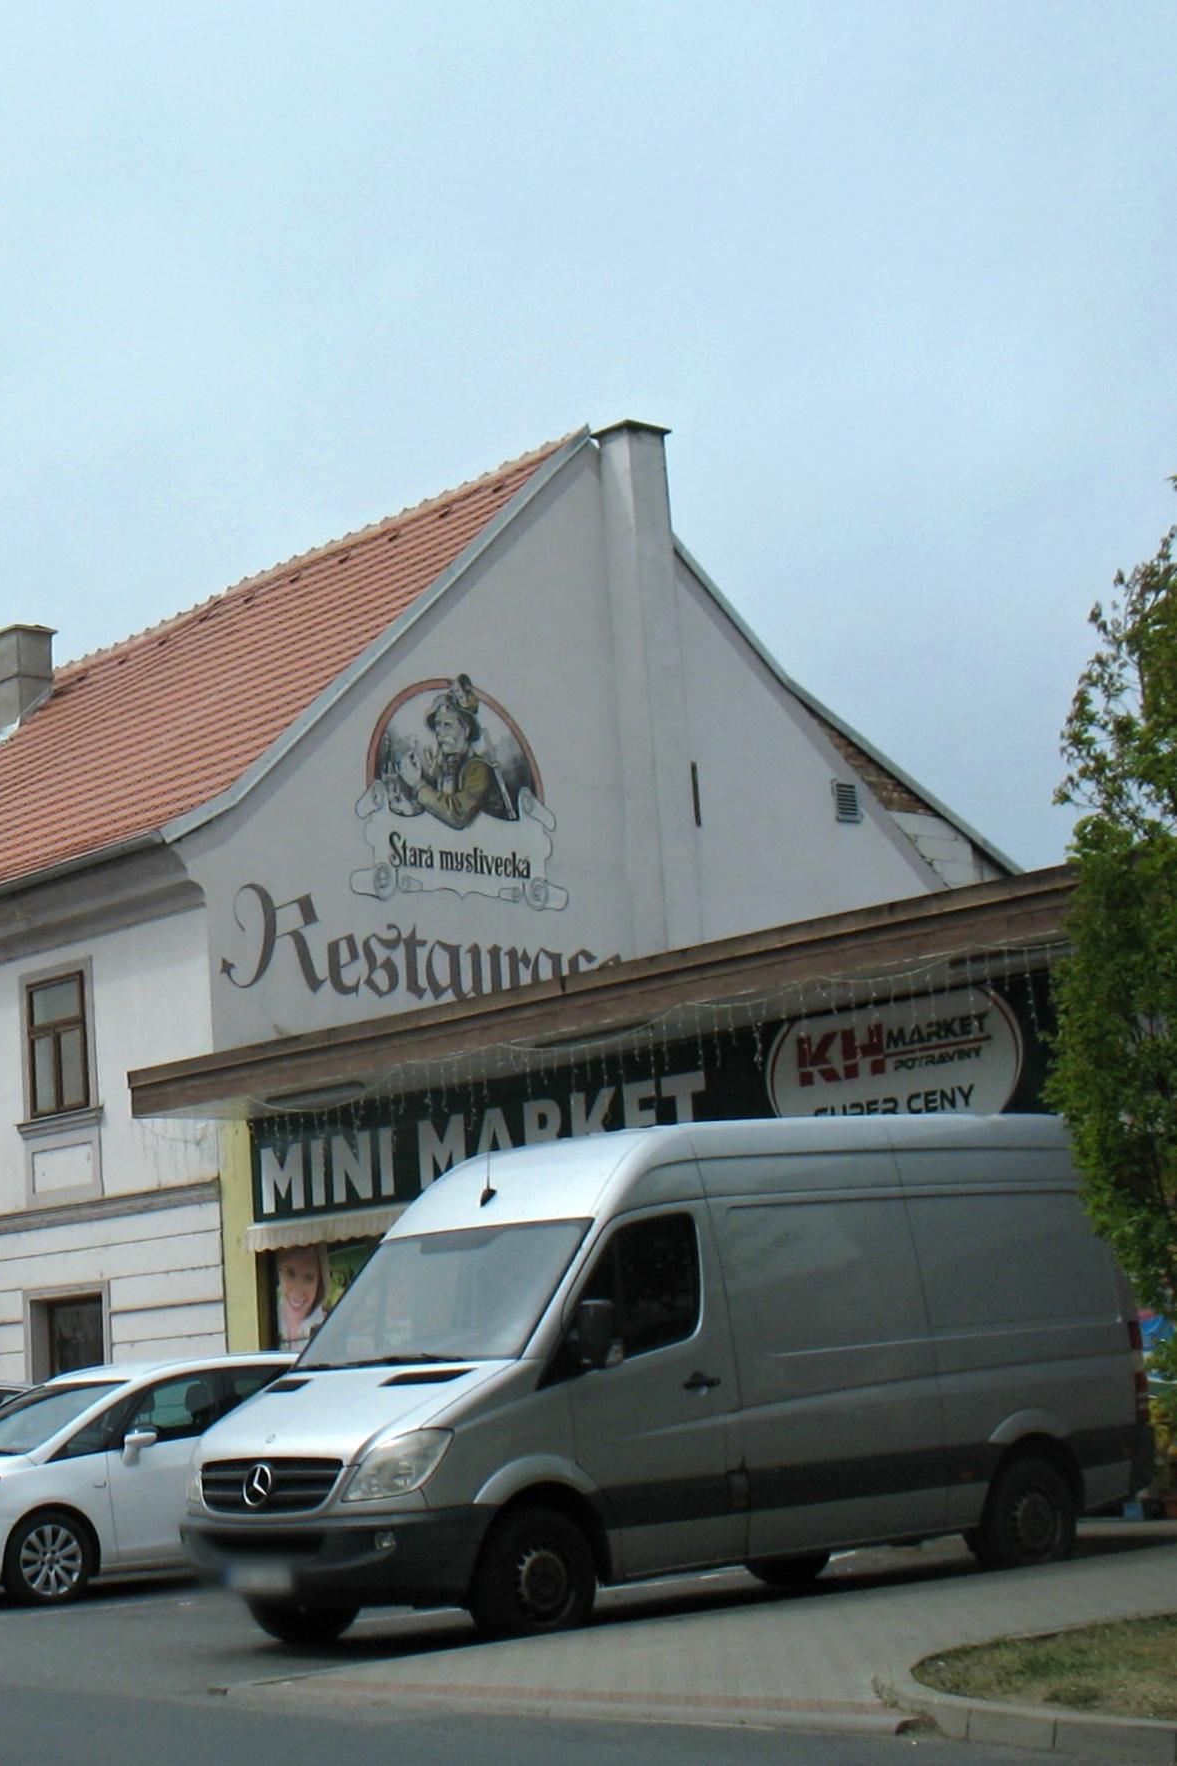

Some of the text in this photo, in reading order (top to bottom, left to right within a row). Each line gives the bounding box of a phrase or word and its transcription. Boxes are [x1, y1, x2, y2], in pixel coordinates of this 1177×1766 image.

[389, 831, 531, 879] Stará myslivecká
[797, 1013, 989, 1087] KH MARKET
[907, 1083, 975, 1114] CENY
[260, 1071, 706, 1214] MINI MARKET
